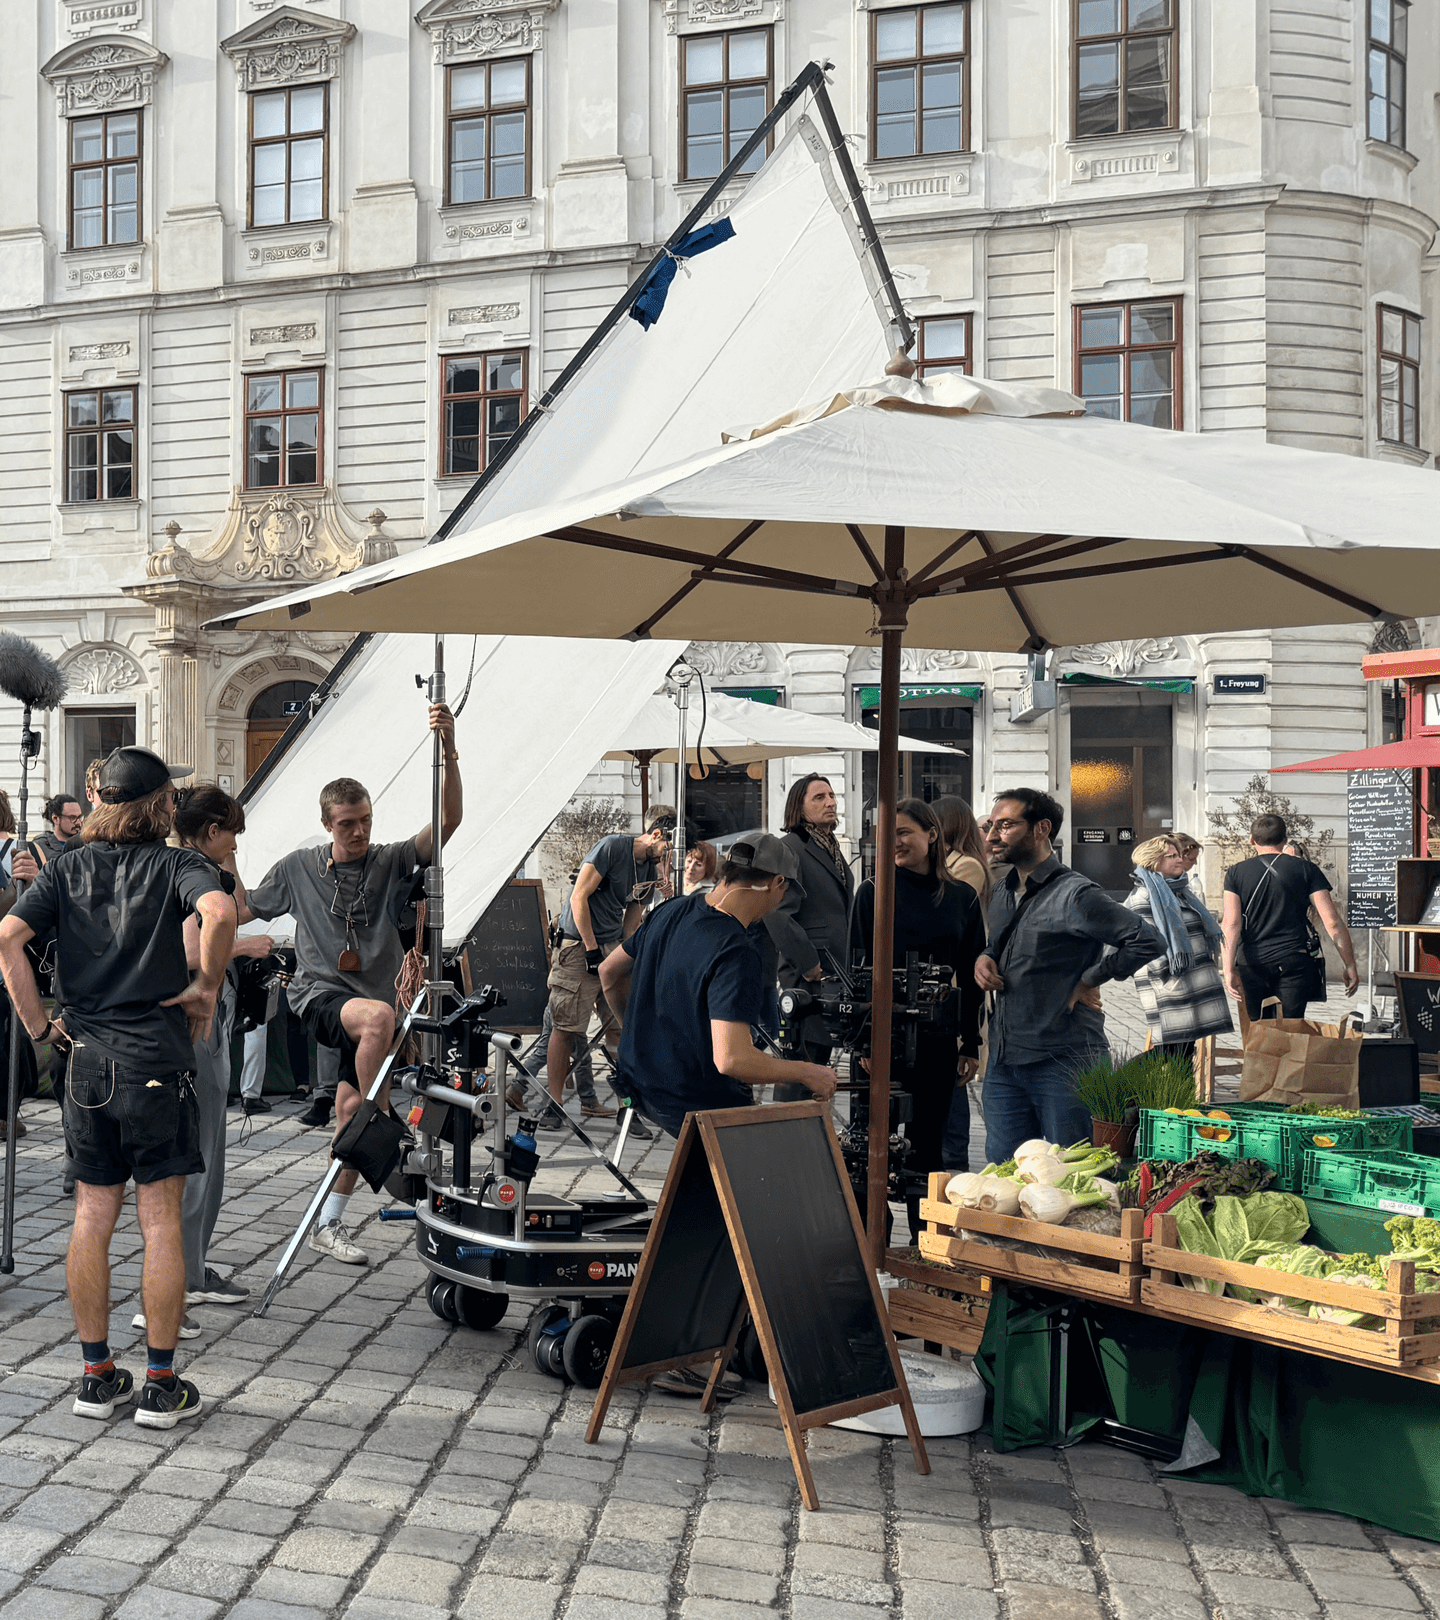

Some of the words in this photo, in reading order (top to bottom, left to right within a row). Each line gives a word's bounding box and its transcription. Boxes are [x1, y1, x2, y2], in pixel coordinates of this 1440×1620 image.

[1229, 680, 1259, 688] Freyung
[878, 687, 961, 698] OTTAS
[1350, 773, 1393, 789] Zillinger
[839, 1003, 853, 1013] R2
[606, 1262, 638, 1278] PAN
